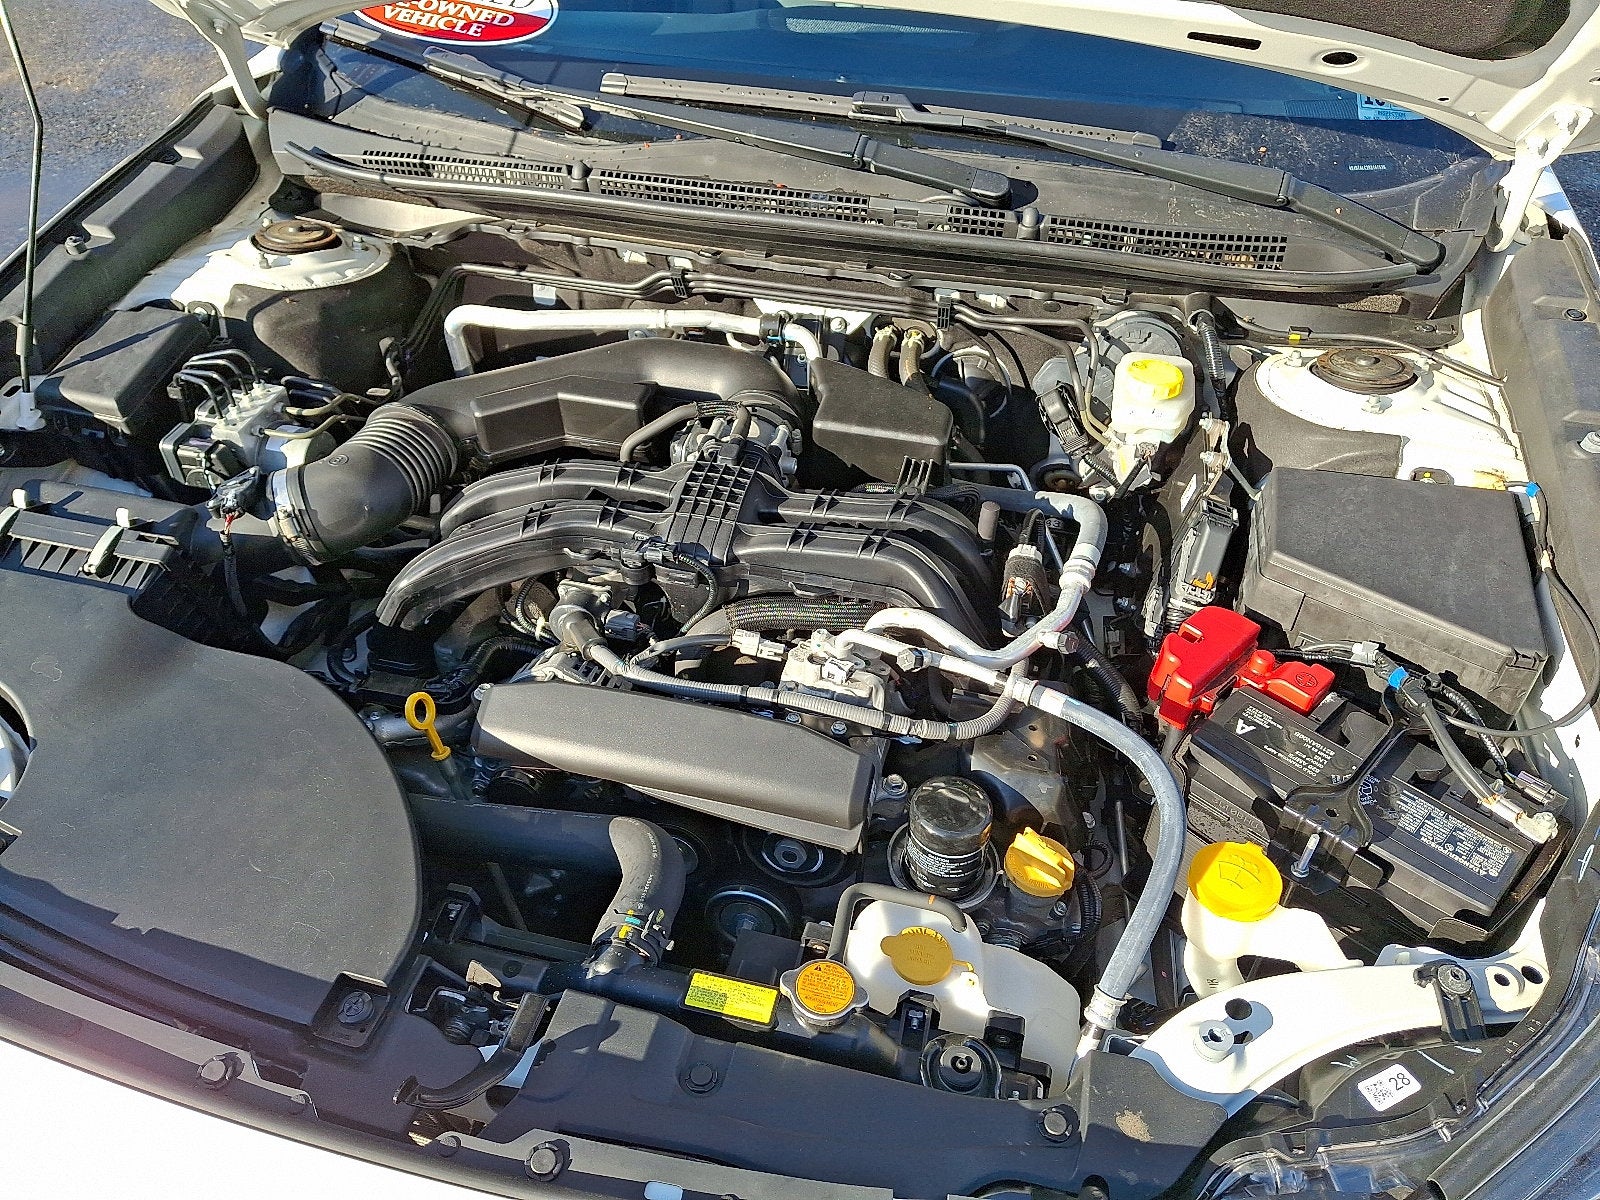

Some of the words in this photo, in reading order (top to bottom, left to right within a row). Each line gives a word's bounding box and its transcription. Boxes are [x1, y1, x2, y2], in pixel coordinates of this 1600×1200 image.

[384, 5, 486, 37] VEHICLE
[1235, 718, 1256, 735] A
[1389, 1073, 1410, 1090] 28
